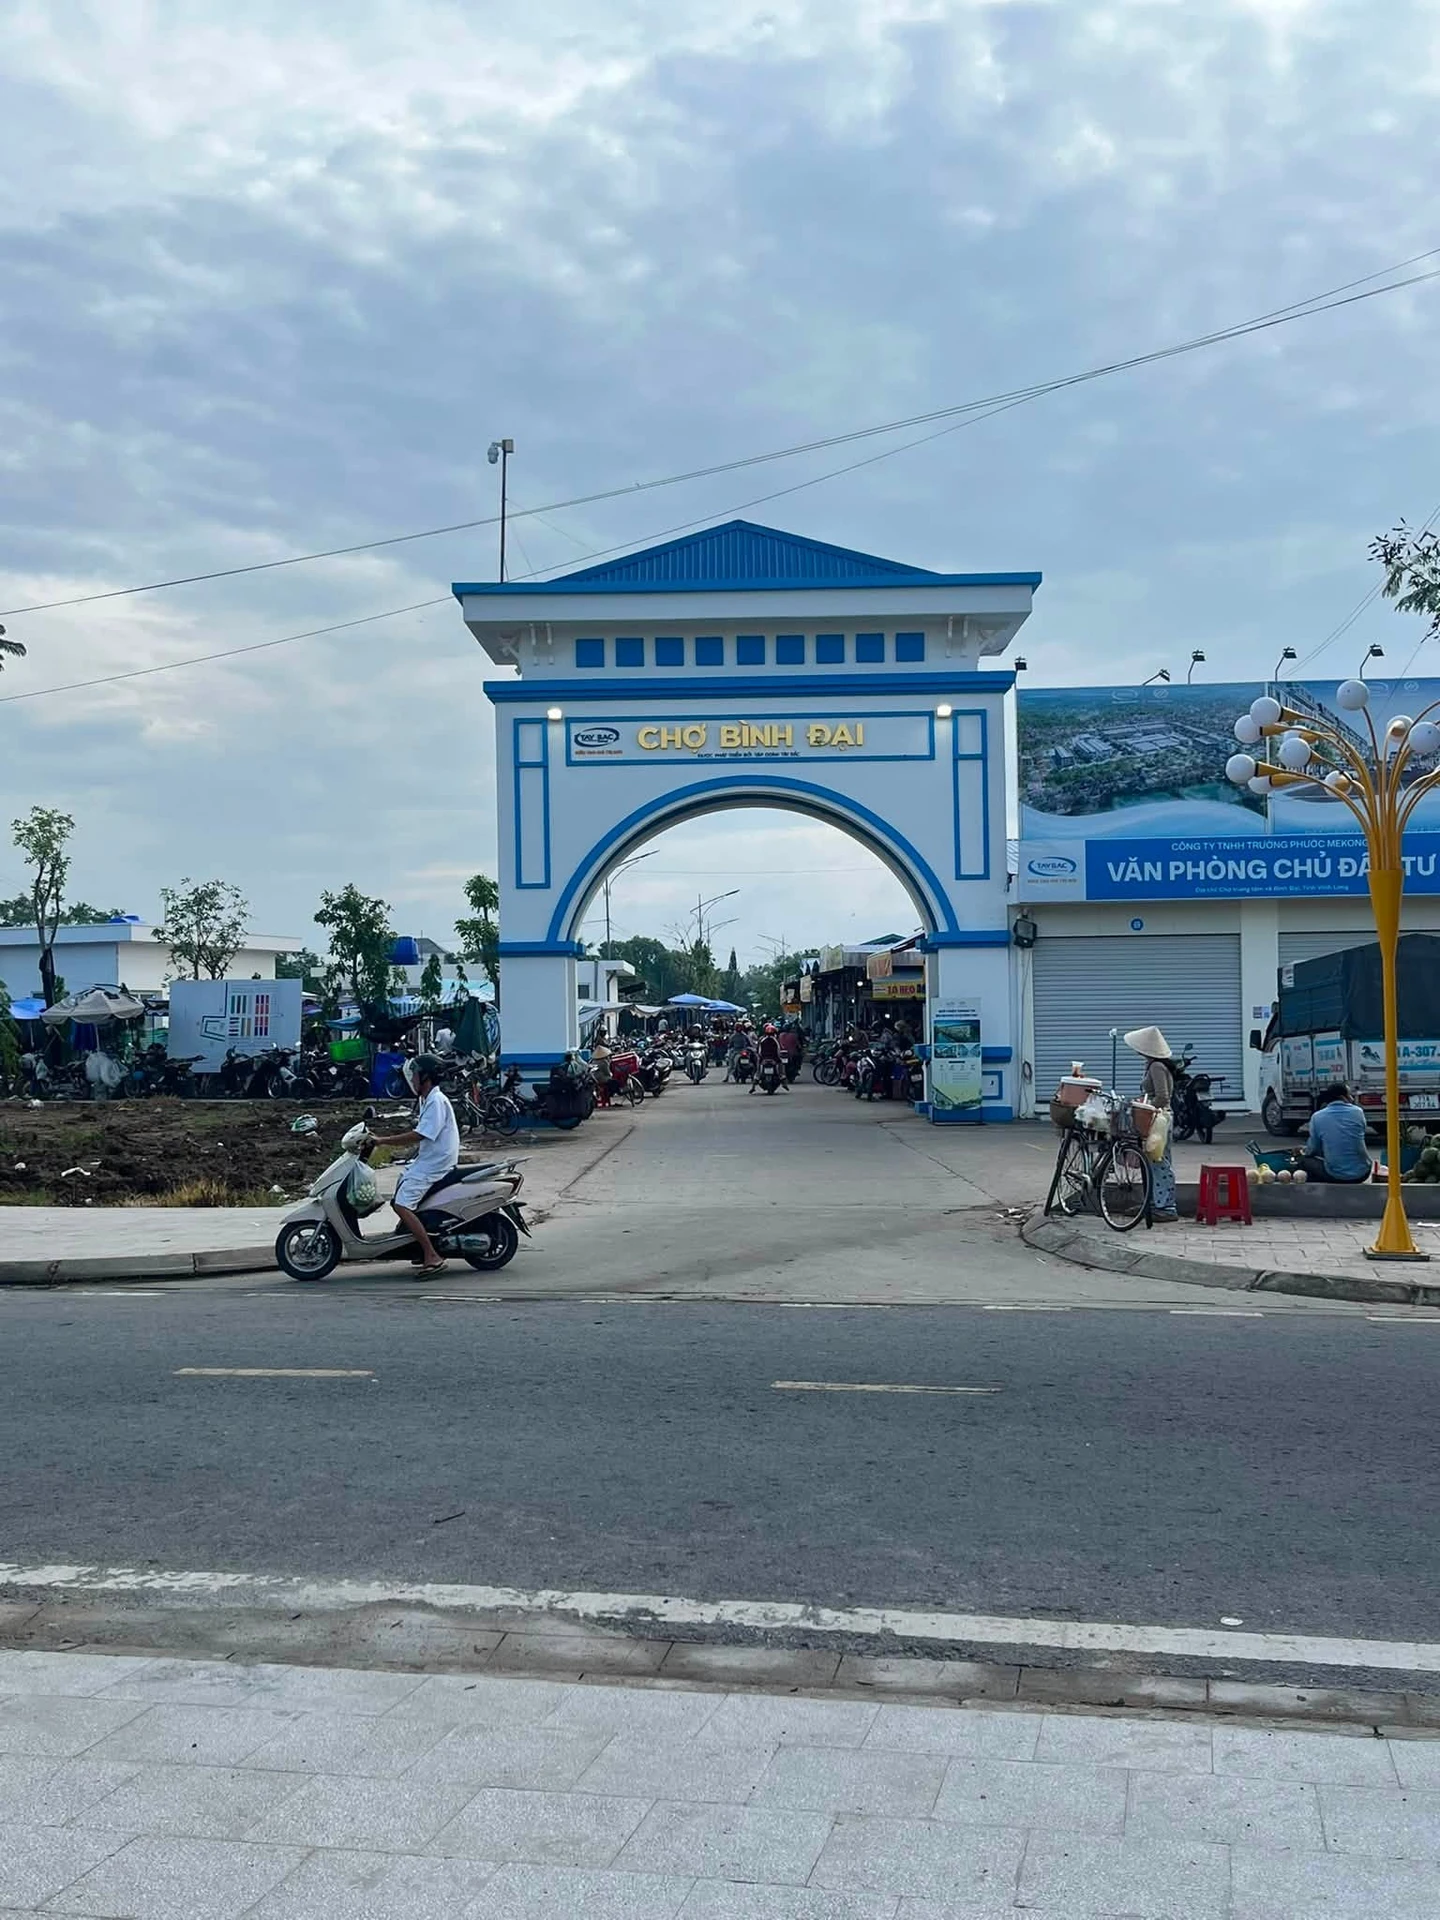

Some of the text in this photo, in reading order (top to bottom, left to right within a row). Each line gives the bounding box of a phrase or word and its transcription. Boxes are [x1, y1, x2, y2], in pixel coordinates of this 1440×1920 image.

[637, 719, 864, 754] CHỢ BÌNH ĐẠI
[1171, 841, 1201, 851] CÔNG
[1203, 842, 1216, 850] TY
[1217, 841, 1245, 850] TNHH
[1107, 856, 1162, 882] VĂN
[1169, 855, 1268, 881] PHÒNG
[1273, 851, 1331, 878] CHỦ
[1401, 854, 1437, 877] TƯ
